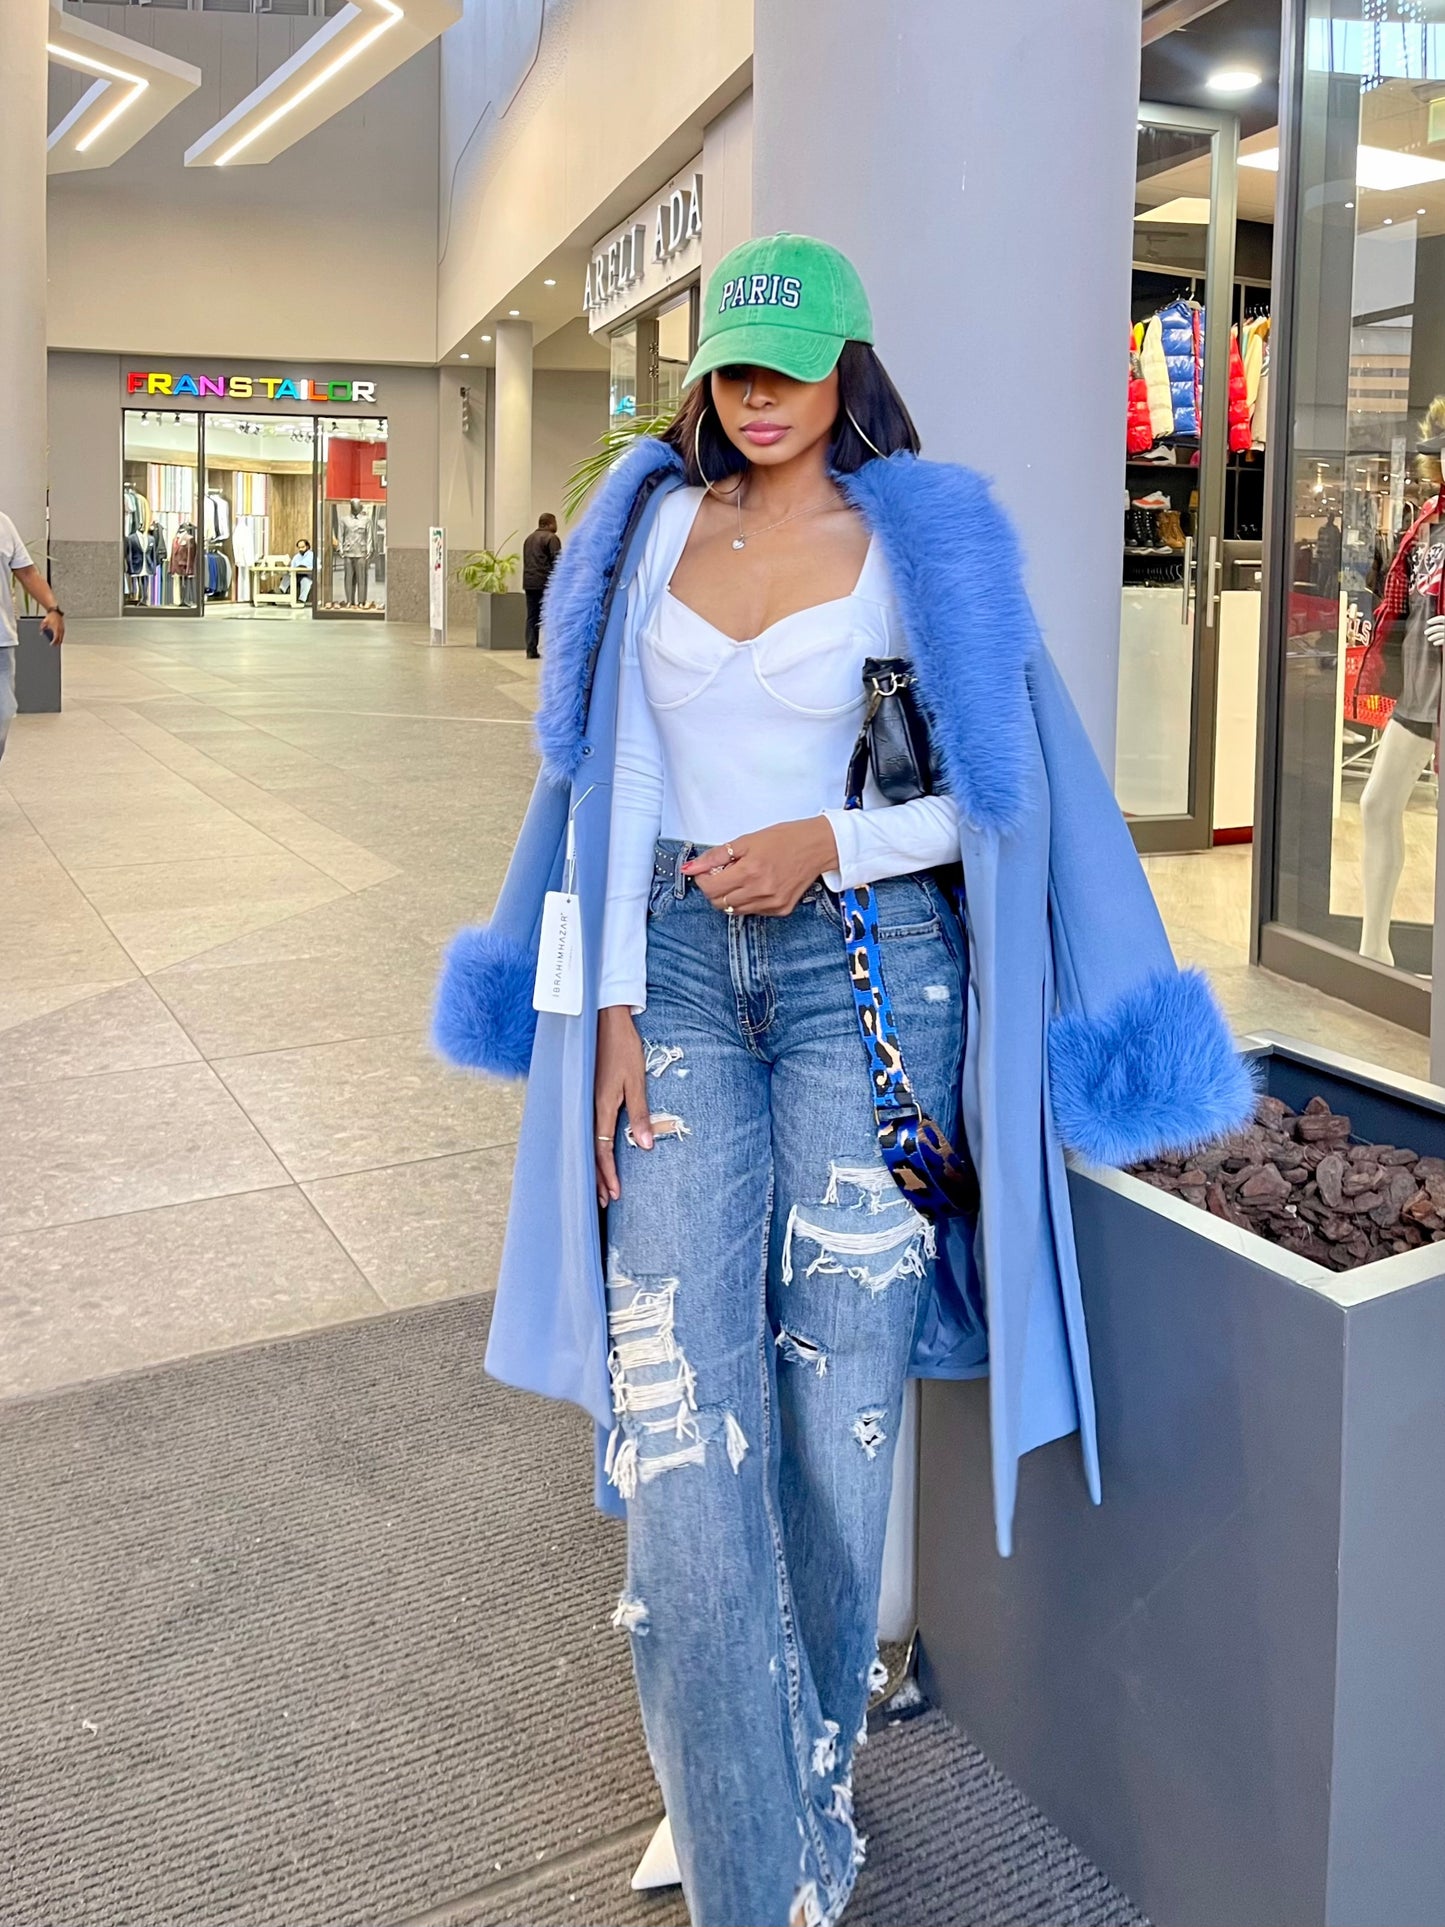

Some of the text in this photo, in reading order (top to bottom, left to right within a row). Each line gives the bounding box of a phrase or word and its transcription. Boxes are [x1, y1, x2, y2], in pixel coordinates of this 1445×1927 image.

[583, 224, 646, 311] ARELI
[719, 274, 802, 313] PARIS
[127, 372, 377, 402] FRANS TAILOR
